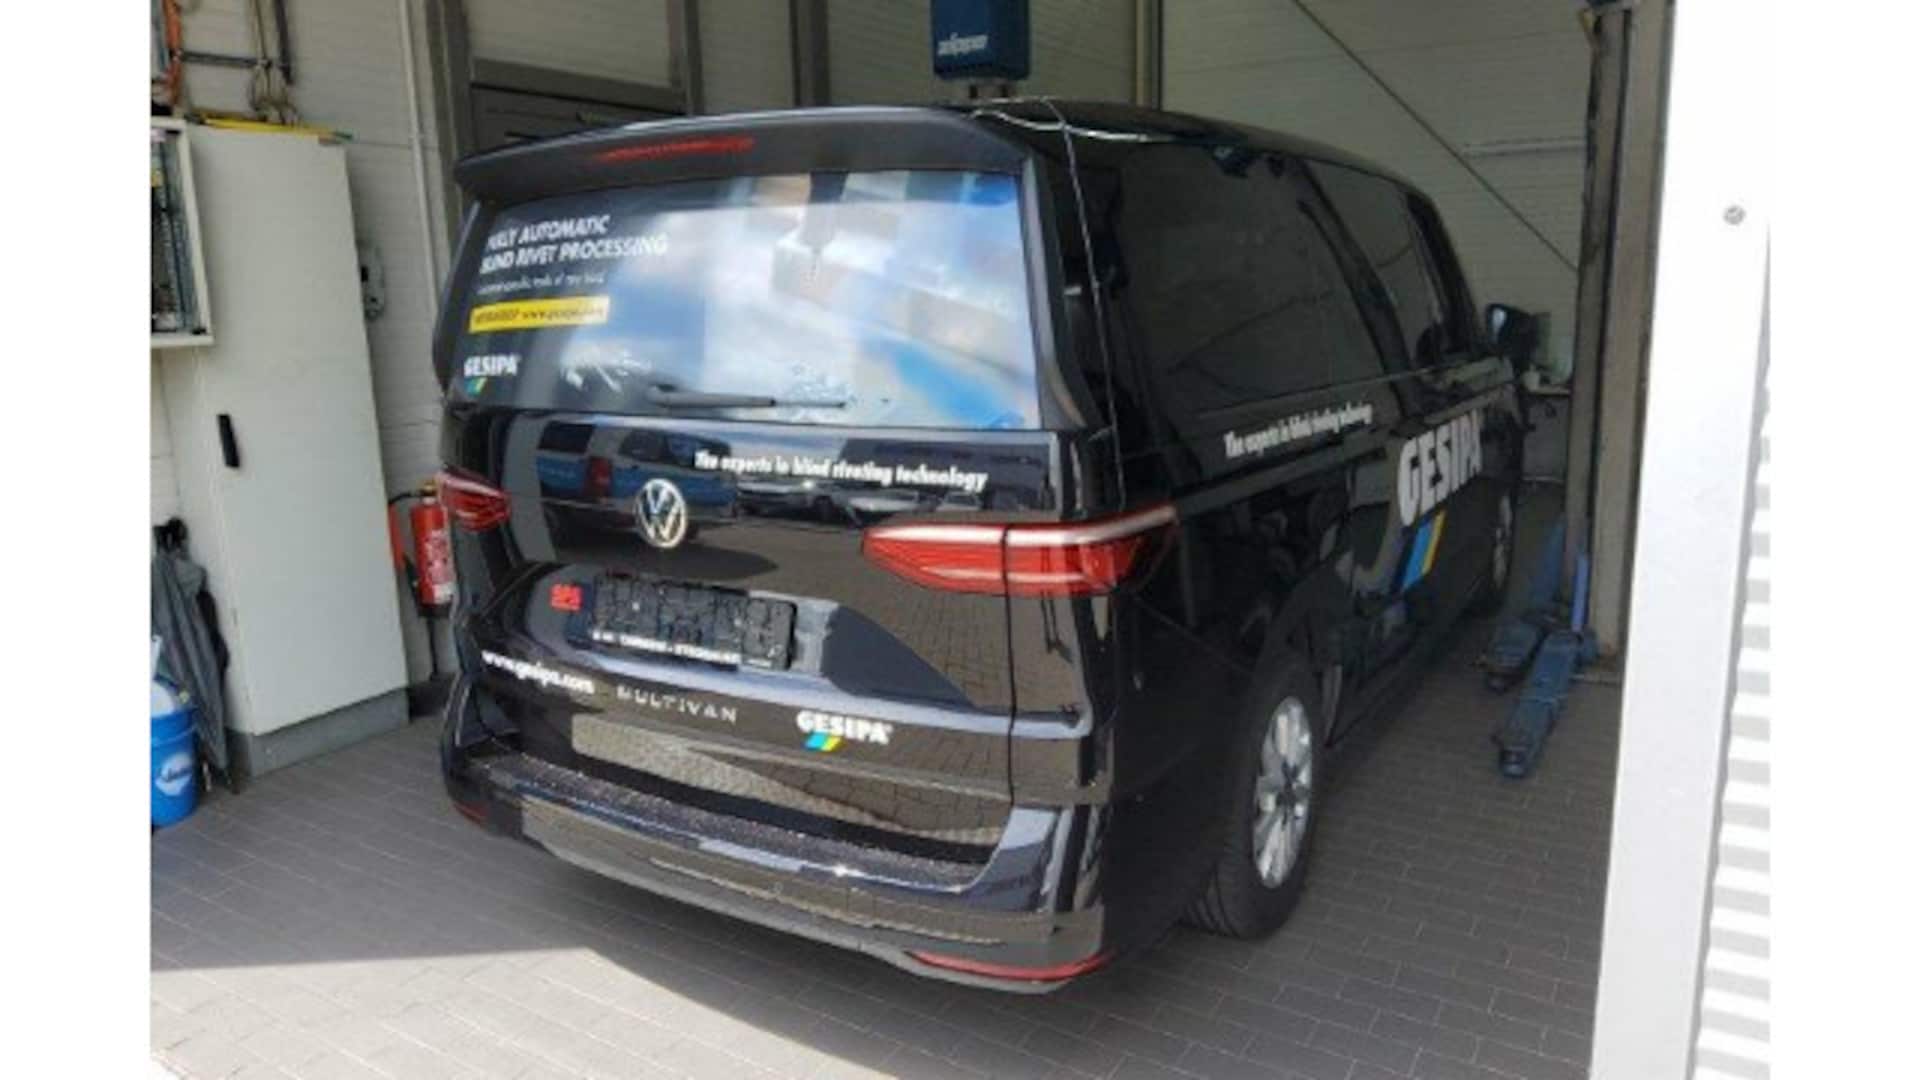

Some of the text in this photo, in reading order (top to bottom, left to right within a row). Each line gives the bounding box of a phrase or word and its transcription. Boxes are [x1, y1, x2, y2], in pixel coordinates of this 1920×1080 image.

[518, 214, 611, 244] AUTOMATIC
[516, 245, 558, 268] RIVET
[558, 233, 669, 262] PROCESSING
[695, 450, 989, 494] The experts in blind riveting technology
[617, 684, 737, 725] MULTIVAN
